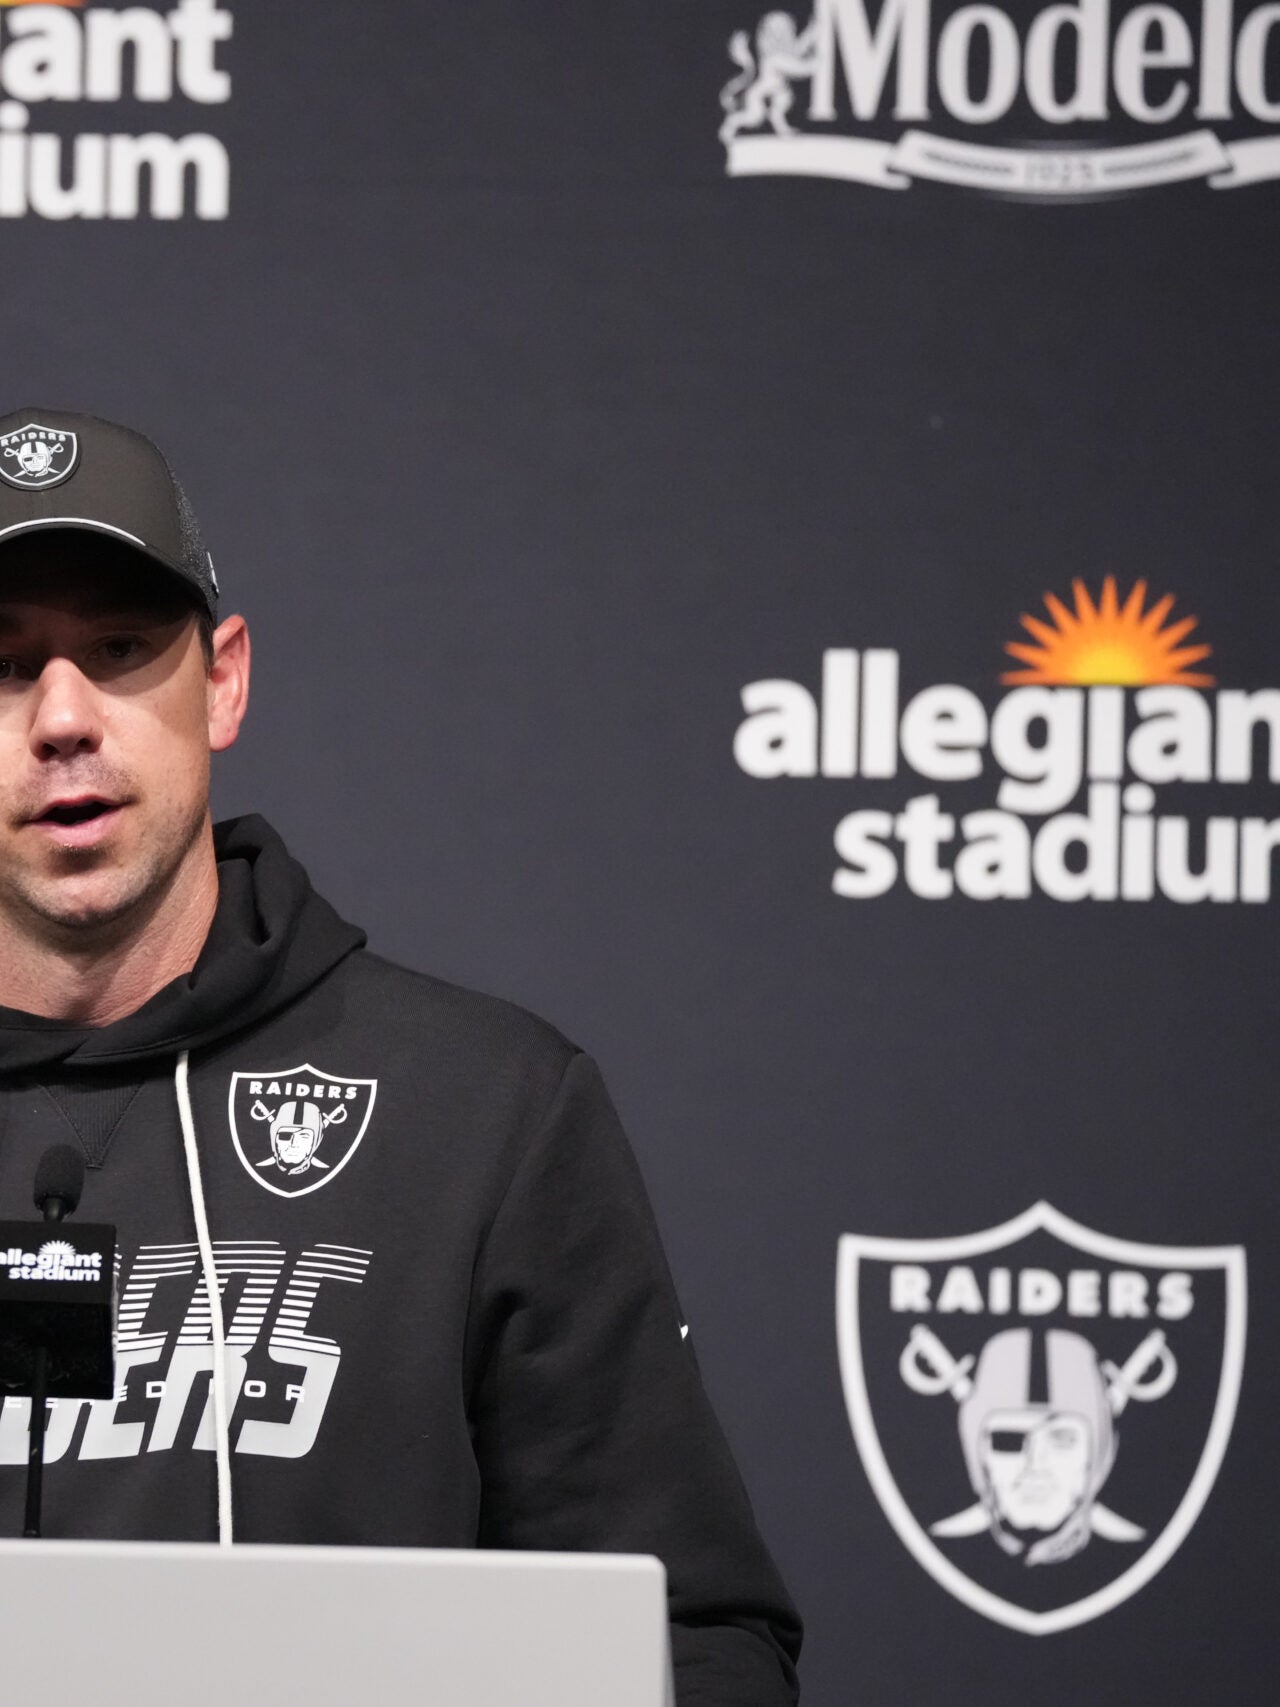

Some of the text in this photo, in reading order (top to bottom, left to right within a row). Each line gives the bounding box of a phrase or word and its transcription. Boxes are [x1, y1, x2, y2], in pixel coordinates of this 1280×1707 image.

[0, 432, 66, 447] RAIDERS
[249, 1081, 358, 1100] RAIDERS
[8, 1266, 101, 1282] stadium
[889, 1265, 1195, 1320] RAIDERS
[208, 1379, 306, 1403] OR
